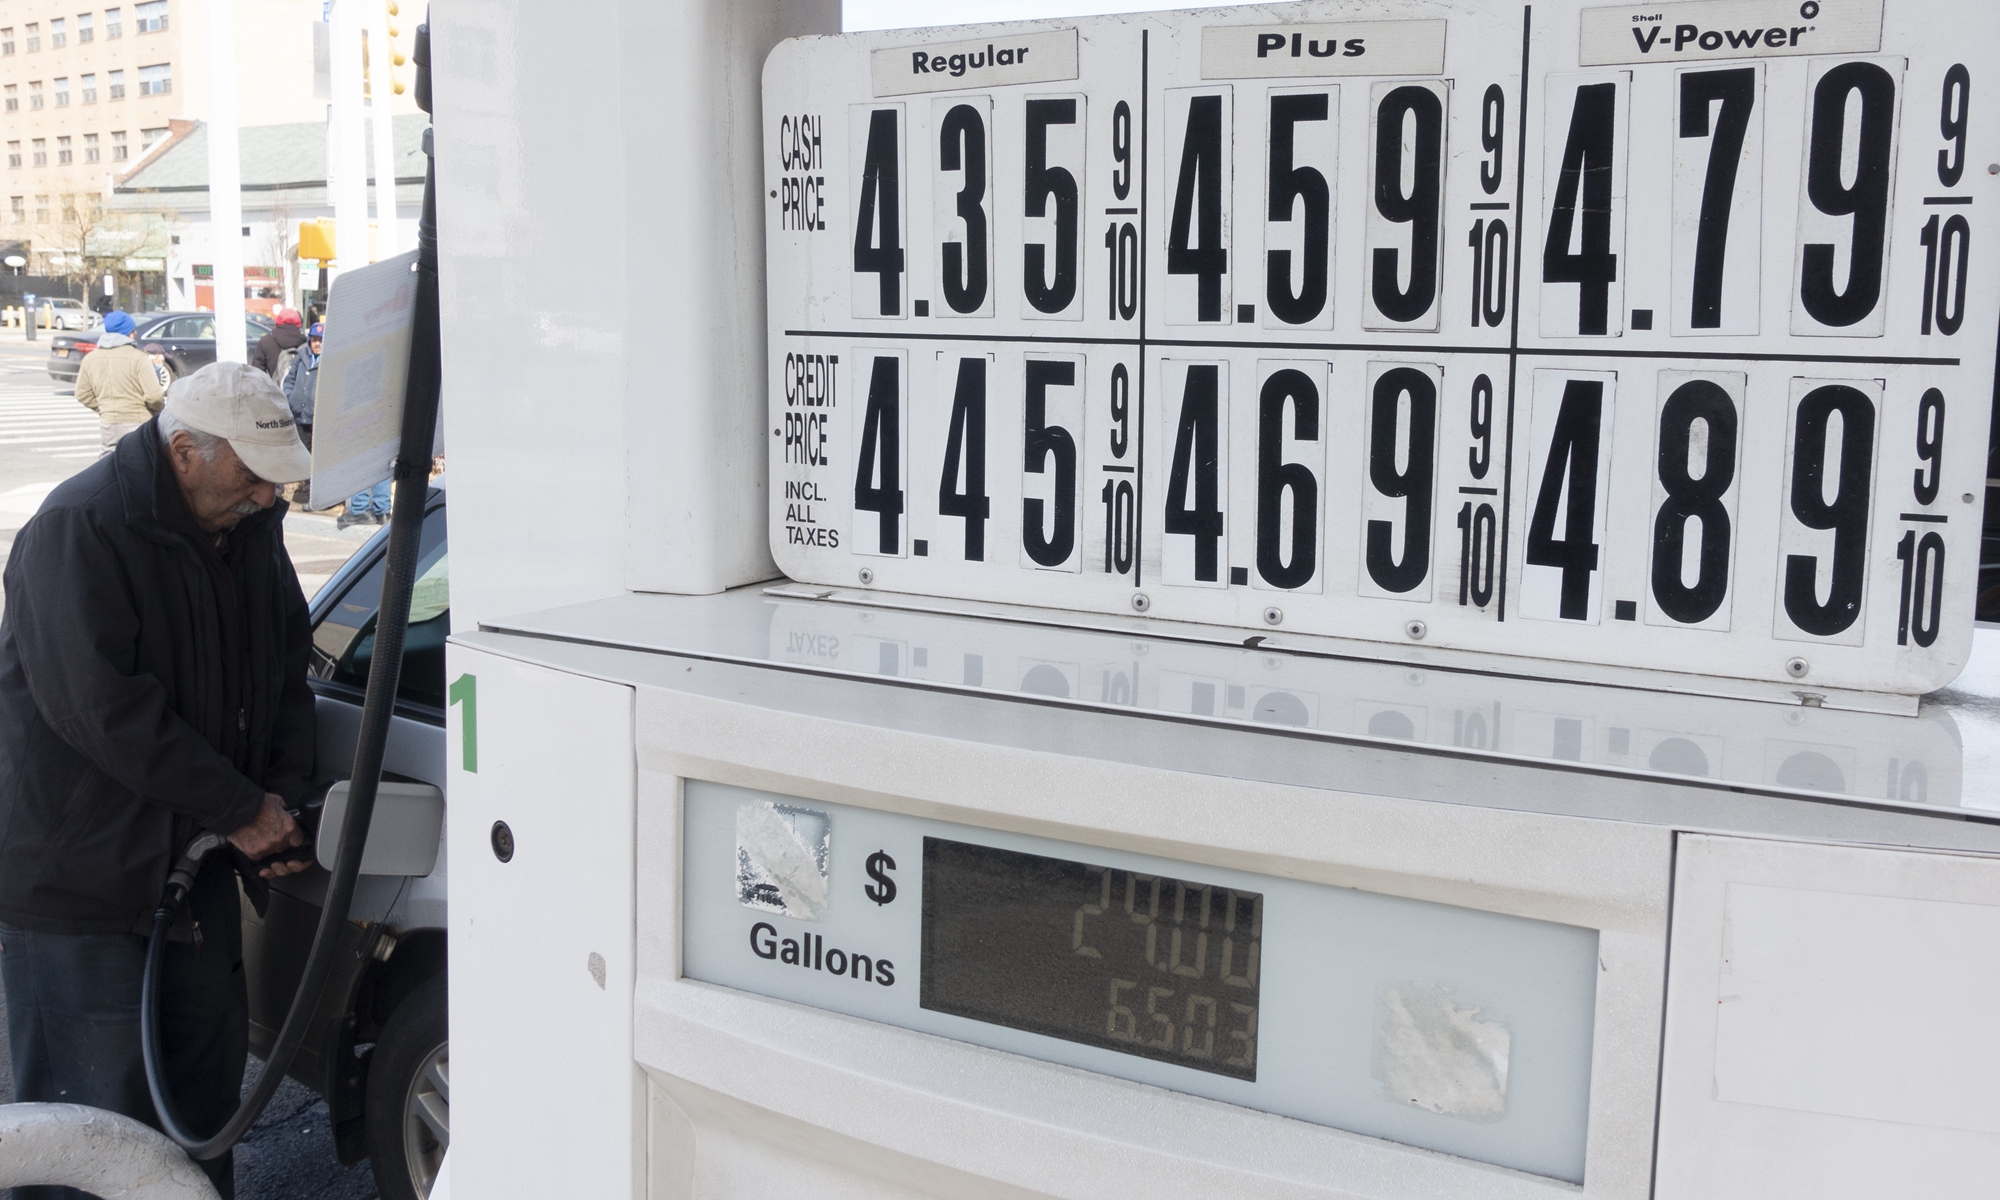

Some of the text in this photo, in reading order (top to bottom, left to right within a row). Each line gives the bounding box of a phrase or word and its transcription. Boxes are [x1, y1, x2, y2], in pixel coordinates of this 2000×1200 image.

[912, 44, 1029, 77] Regular
[1257, 33, 1366, 58] Plus
[1632, 14, 1662, 22] Shell
[1632, 24, 1807, 53] V-Power
[780, 114, 822, 172] CASH
[1112, 100, 1131, 201] 9
[1480, 83, 1505, 195] 9
[1937, 63, 1970, 188] 9
[781, 175, 825, 232] PRICE
[853, 98, 1079, 317] 4.35
[1167, 85, 1443, 325] 4.59
[1542, 61, 1896, 336] 4.79
[1105, 222, 1138, 325] 10
[1468, 218, 1509, 329] 10
[1920, 214, 1970, 336] 10
[255, 420, 279, 429] North
[785, 352, 839, 407] CREDIT
[1110, 362, 1129, 459] 9
[1469, 373, 1493, 480] 9
[785, 412, 828, 467] PRICE
[854, 356, 1077, 567] 4.45
[1164, 364, 1437, 593] 4.69
[1913, 387, 1946, 506] 9
[785, 481, 827, 502] INCL.
[785, 525, 839, 548] TAXES
[786, 503, 816, 524] ALL
[1101, 478, 1134, 575] 10
[1526, 379, 1876, 636] 4.89
[1457, 501, 1496, 608] 10
[1896, 530, 1946, 648] 10
[449, 672, 478, 774] 1
[864, 849, 897, 907] $
[749, 922, 895, 987] Gallons
